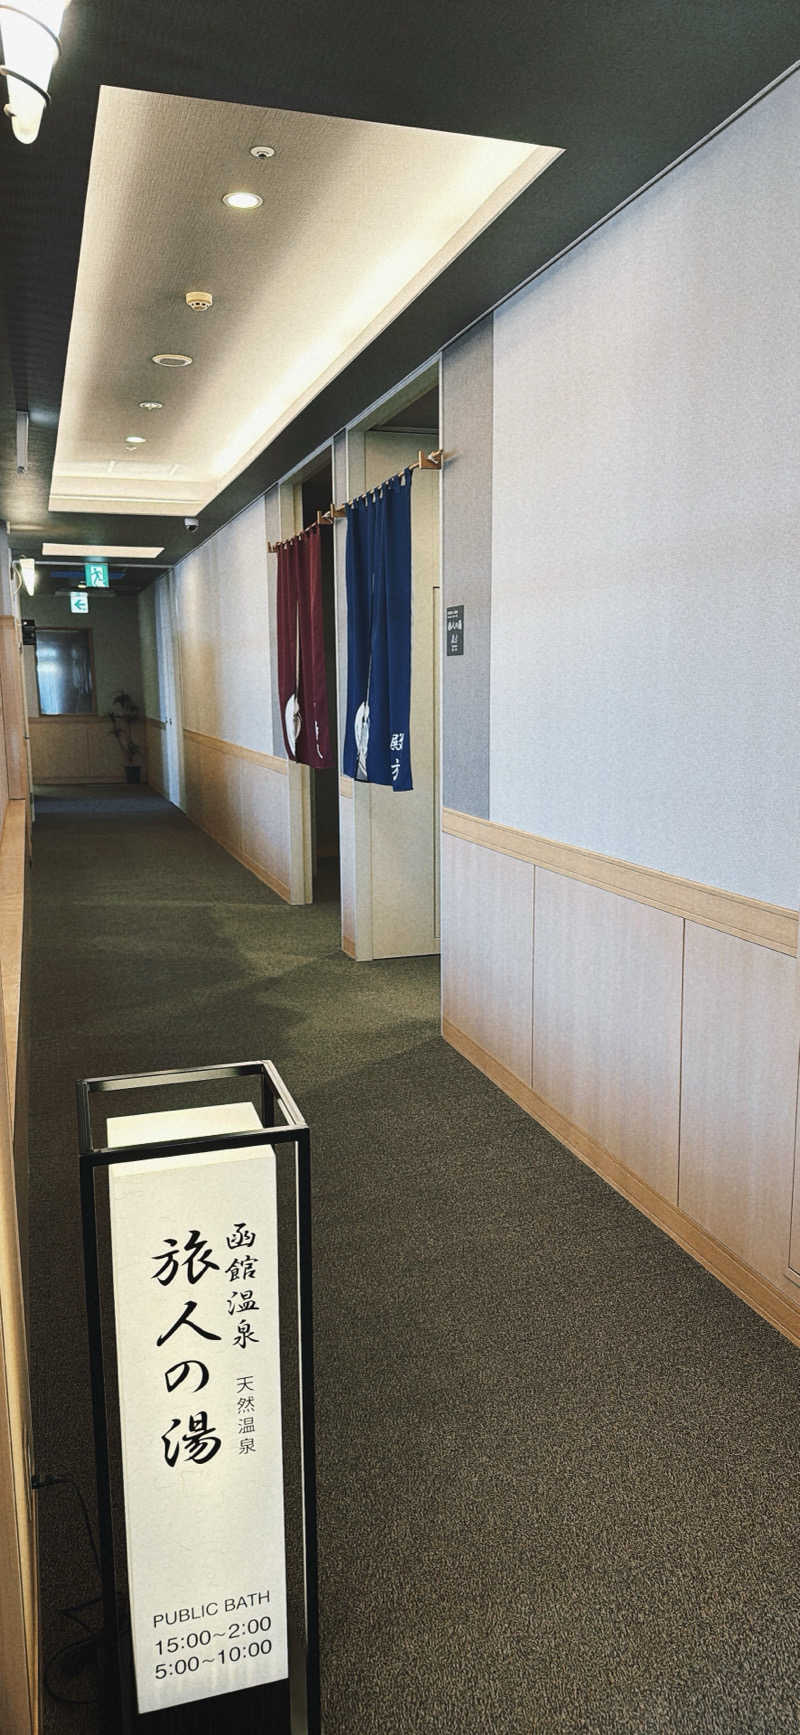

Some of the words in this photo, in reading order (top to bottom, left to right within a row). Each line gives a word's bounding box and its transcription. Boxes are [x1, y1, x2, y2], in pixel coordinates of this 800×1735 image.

[225, 1223, 260, 1349] 函館温泉
[152, 1230, 222, 1467] 旅人の湯
[236, 1375, 256, 1455] 天然温泉
[153, 1602, 218, 1628] PUBLIC
[224, 1591, 270, 1612] BATH
